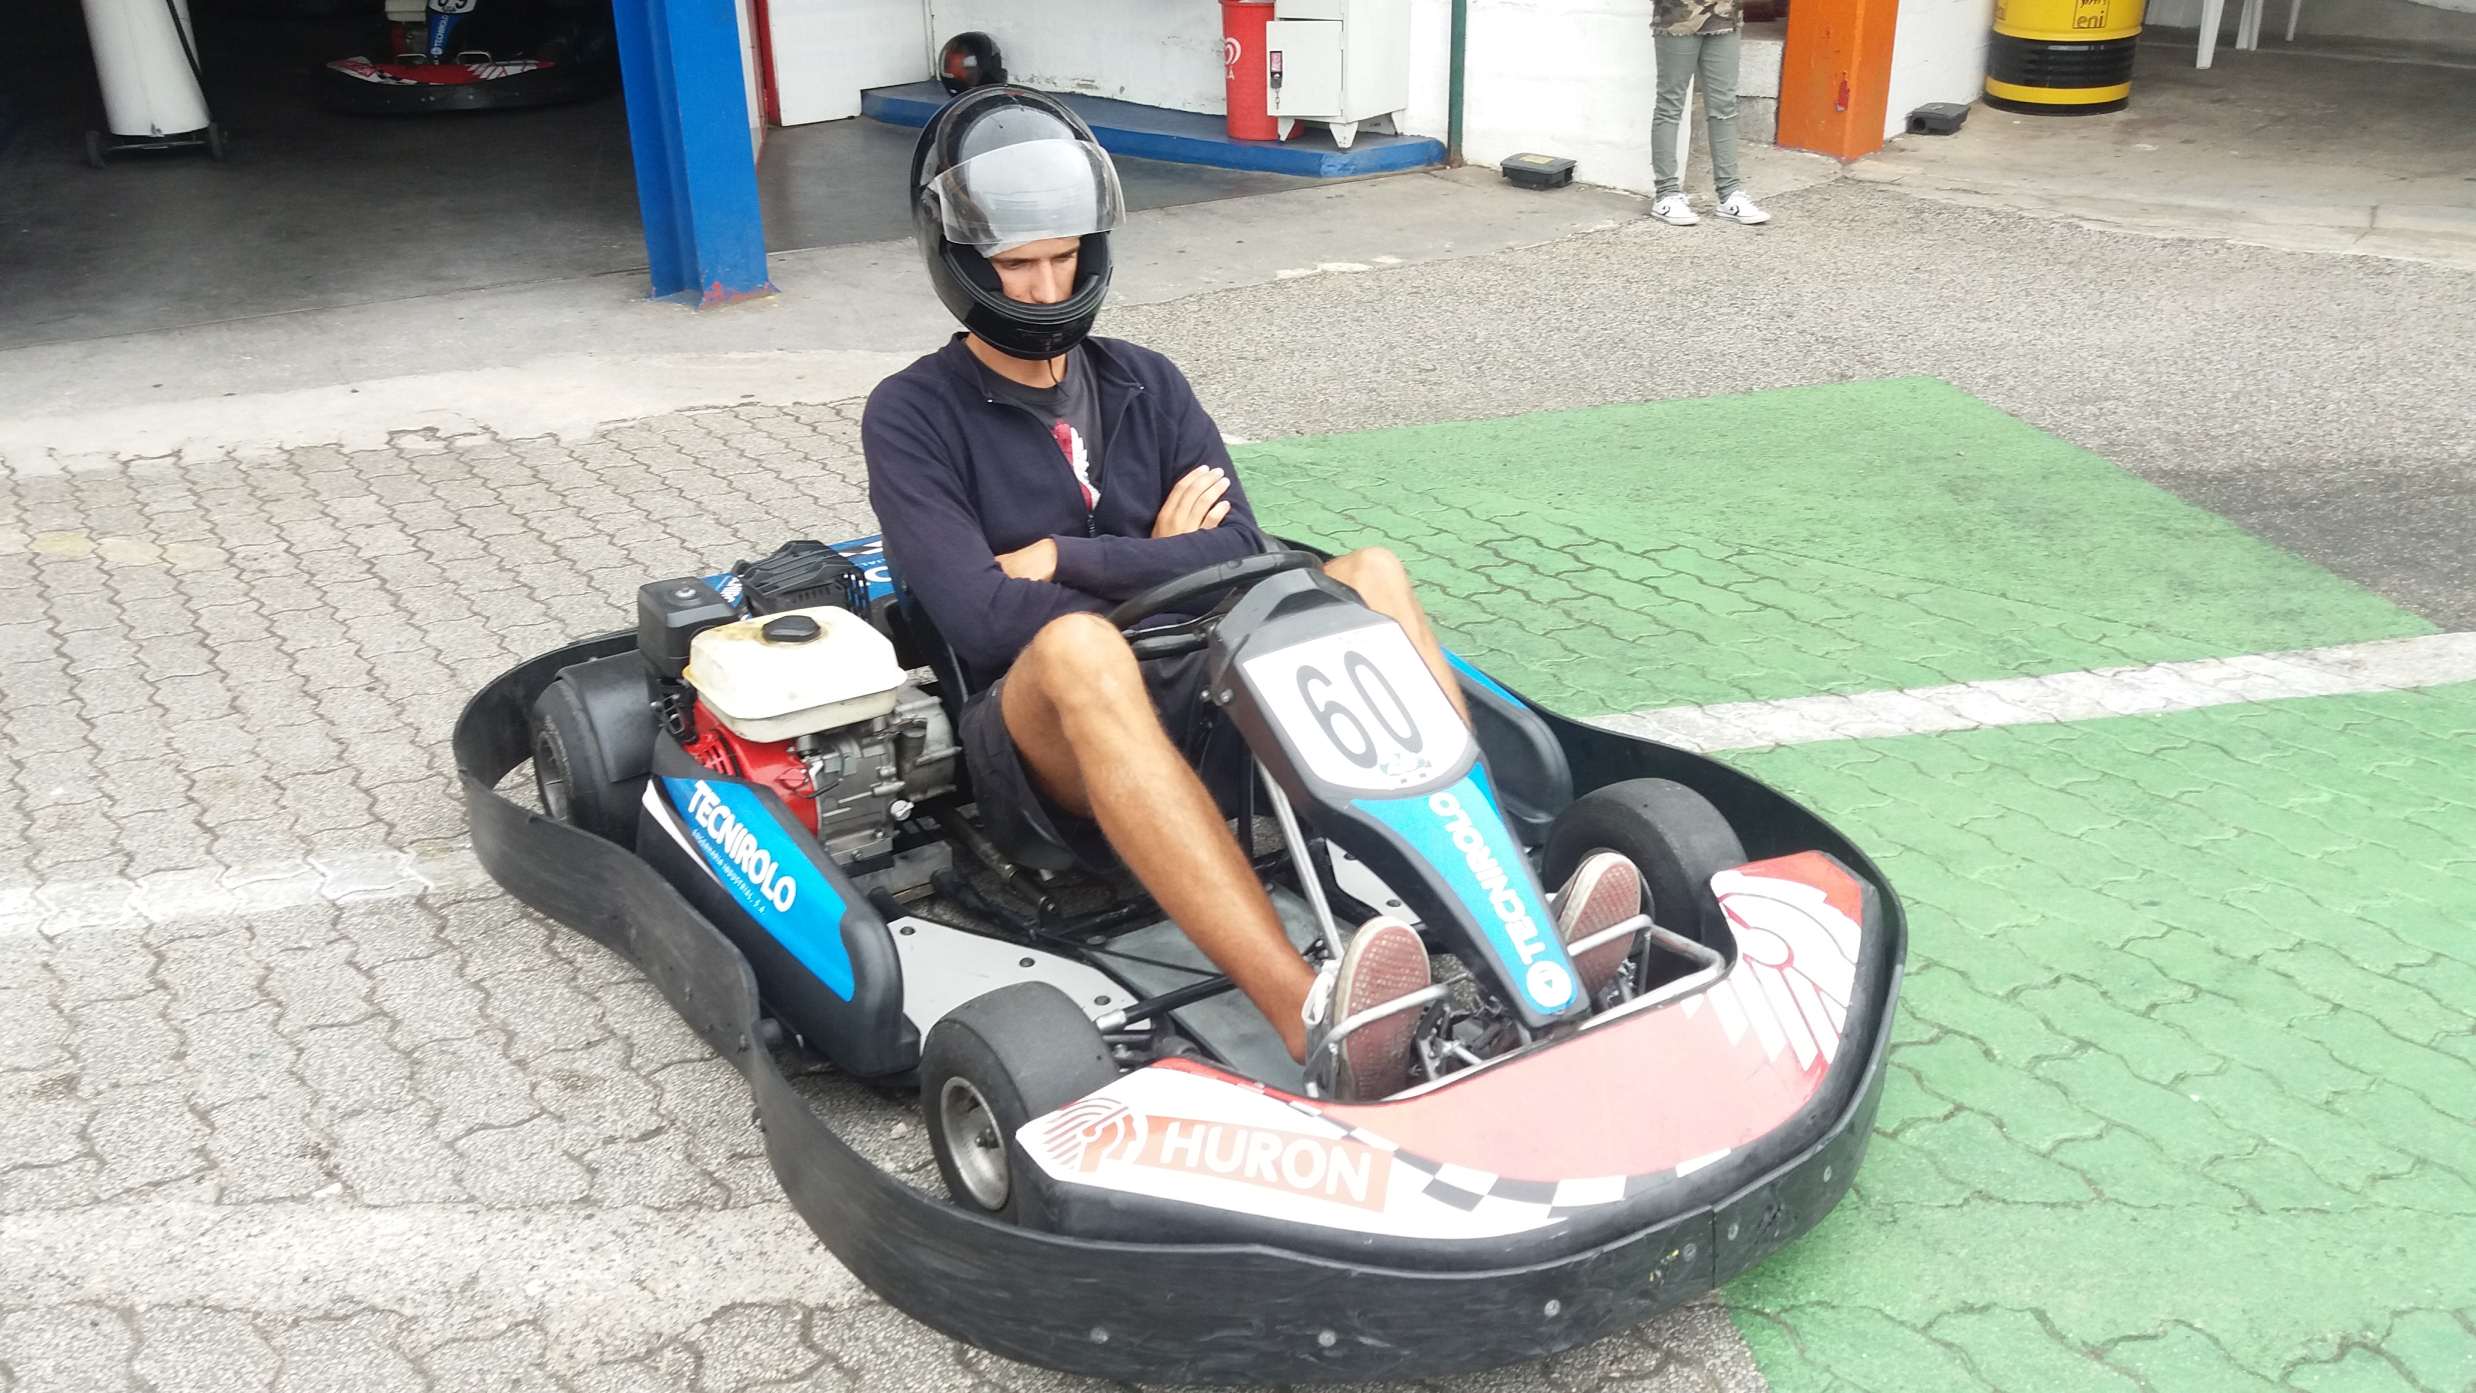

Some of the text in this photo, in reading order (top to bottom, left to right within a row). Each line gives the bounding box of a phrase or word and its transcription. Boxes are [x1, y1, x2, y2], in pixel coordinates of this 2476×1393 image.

[2076, 11, 2105, 28] eni
[1296, 650, 1424, 769] 60
[688, 779, 797, 912] TECNIROLO
[1428, 790, 1546, 966] TECNIROLO
[1159, 1120, 1372, 1202] HURON
